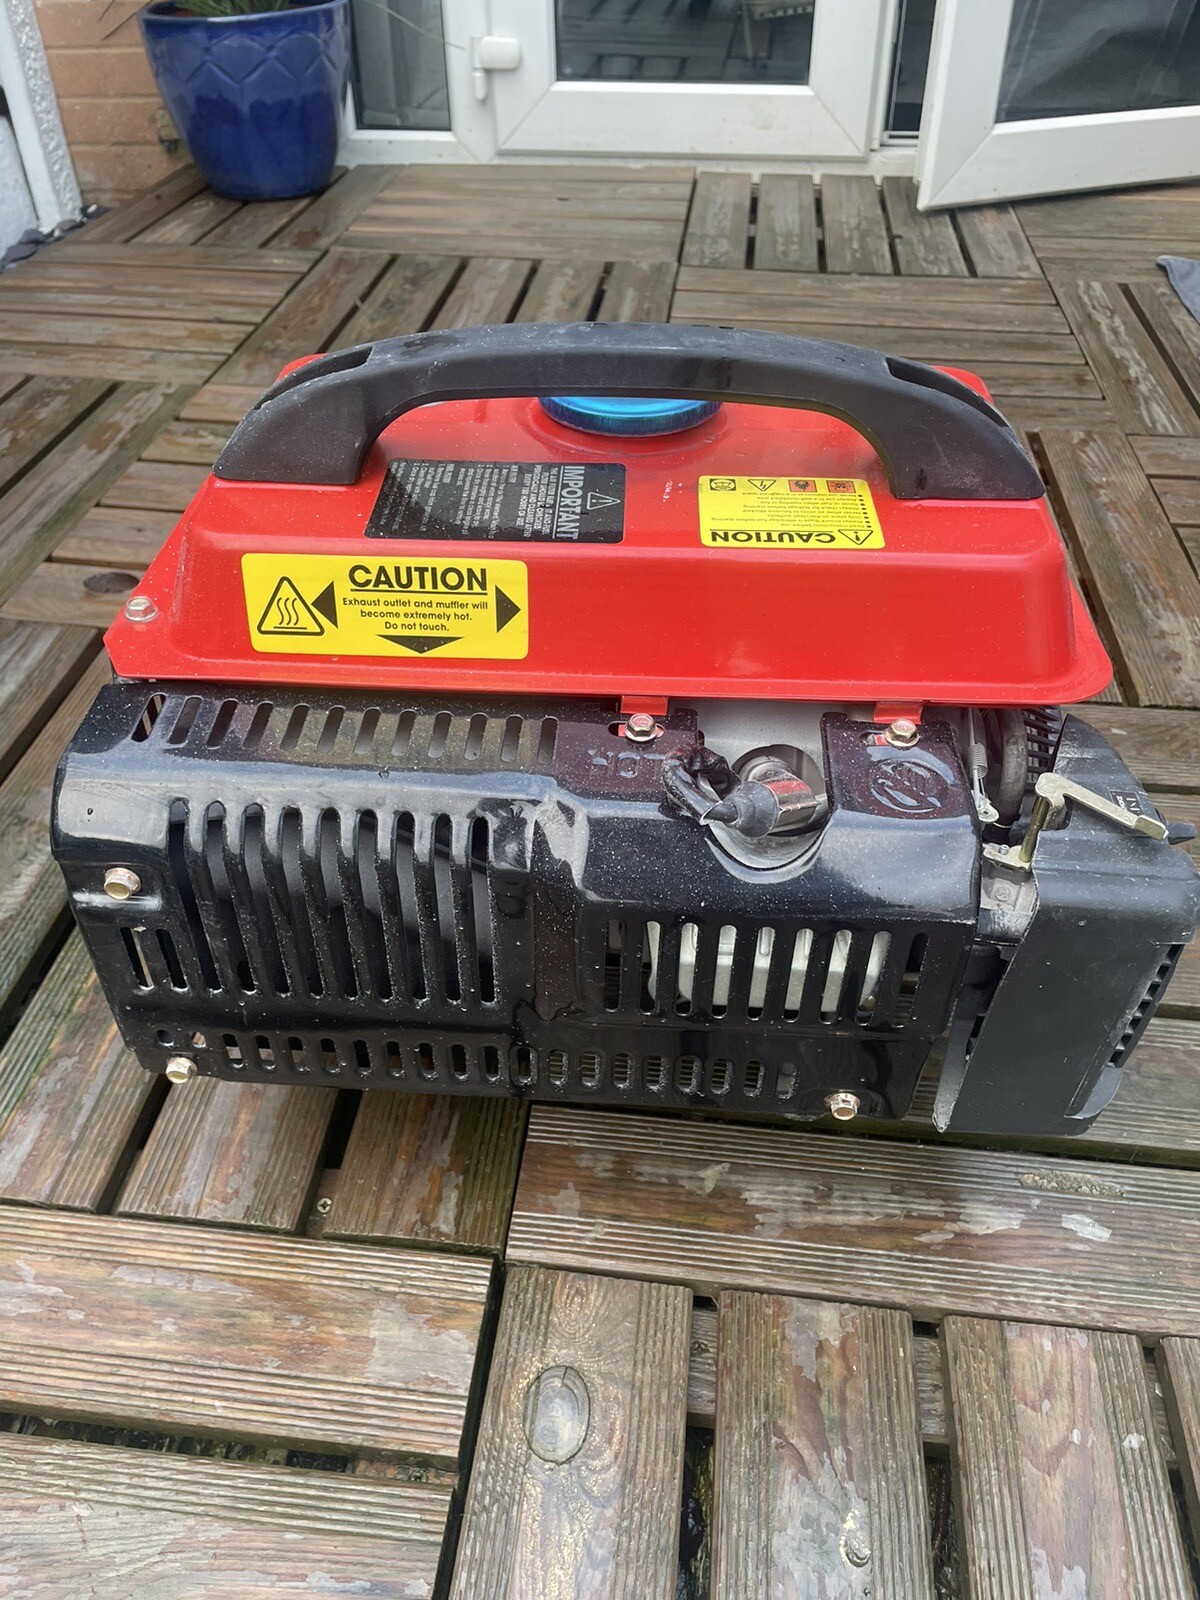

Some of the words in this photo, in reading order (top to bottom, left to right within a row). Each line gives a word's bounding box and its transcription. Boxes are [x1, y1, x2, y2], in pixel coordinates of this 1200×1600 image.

[550, 467, 558, 475] THE
[522, 474, 532, 486] EVERY
[530, 465, 542, 493] PERIODICALLY
[540, 472, 549, 484] FILTER
[538, 485, 547, 501] SHOULD
[547, 483, 556, 495] FILTER
[518, 495, 528, 510] HOURS
[528, 493, 537, 503] AND
[556, 465, 585, 540] IMPORTANT
[525, 503, 535, 523] CLEANED
[533, 507, 544, 529] CHECKED
[543, 514, 552, 524] AND
[523, 523, 532, 537] AFTER
[541, 524, 551, 535] FUEL
[711, 531, 837, 544] CAUTION
[348, 564, 487, 591] CAUTION
[343, 598, 380, 606] Exhaust
[384, 599, 410, 607] outlet
[414, 600, 432, 608] and
[436, 601, 468, 609] muffler
[361, 609, 400, 618] become
[404, 611, 451, 621] extremely
[454, 612, 472, 620] hot.
[401, 622, 416, 630] not
[419, 622, 449, 631] touch.
